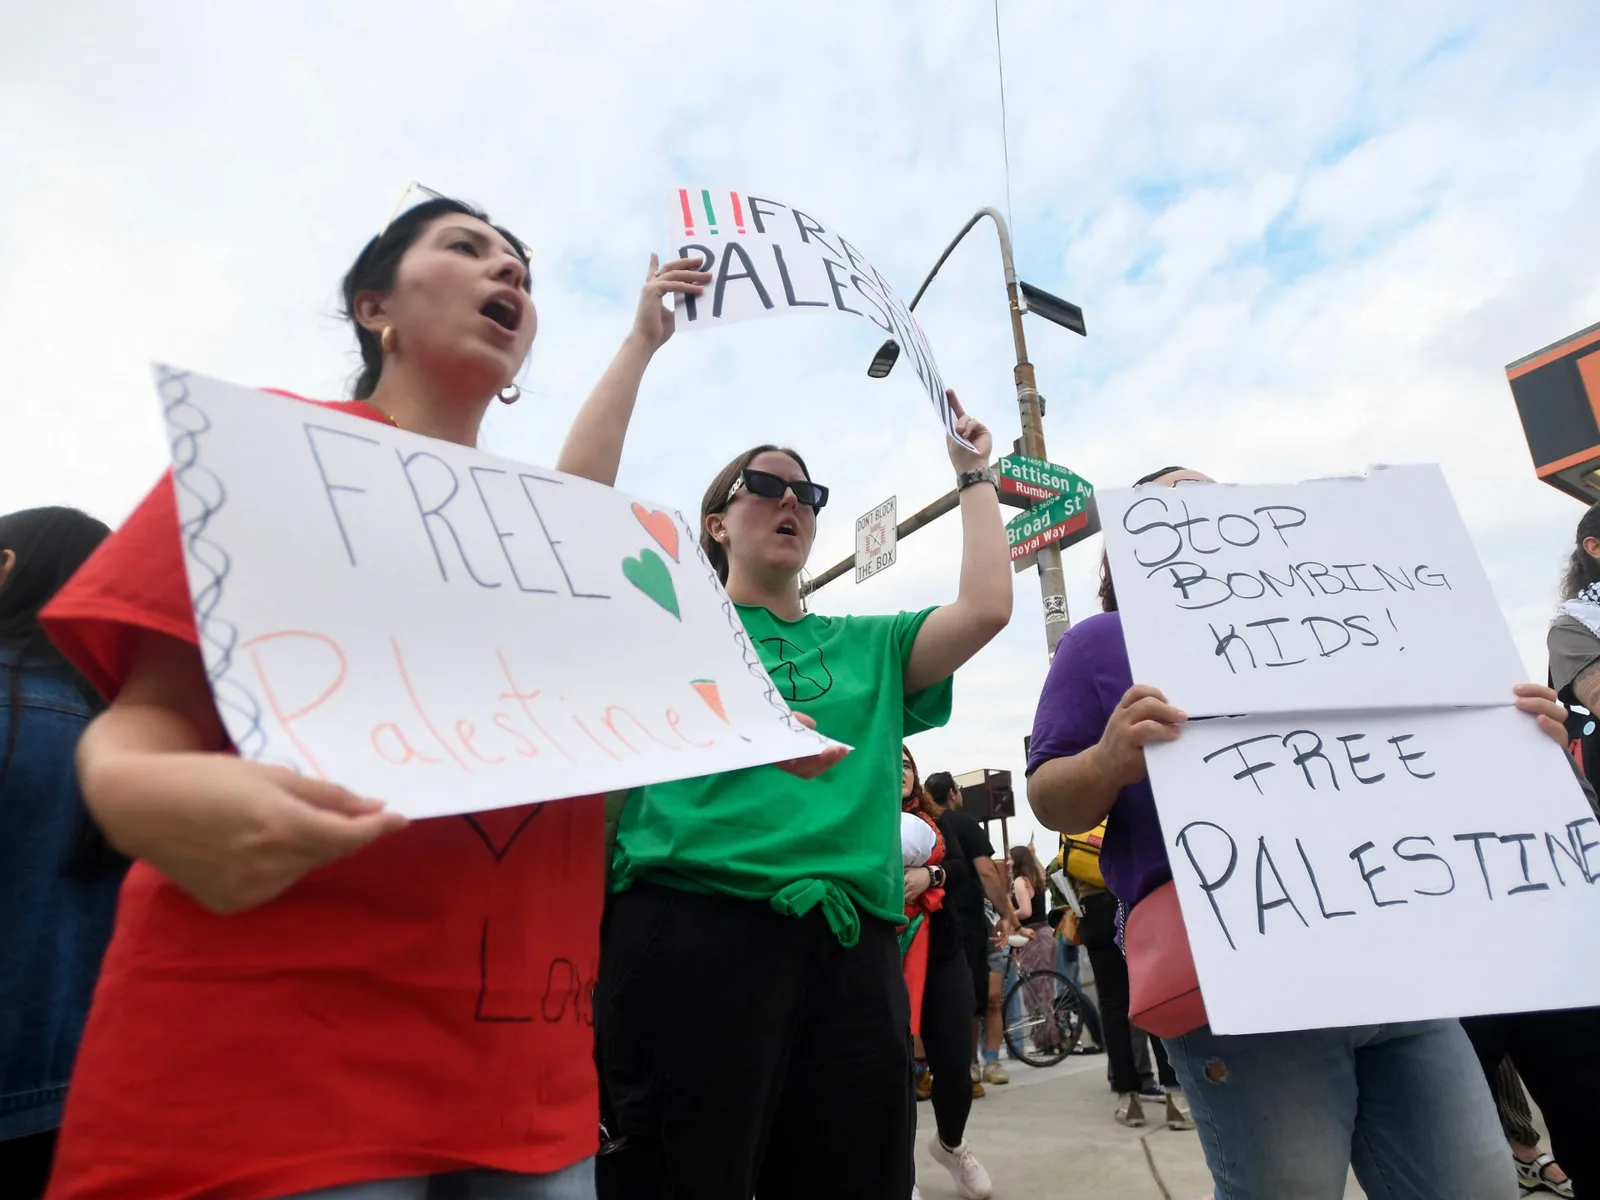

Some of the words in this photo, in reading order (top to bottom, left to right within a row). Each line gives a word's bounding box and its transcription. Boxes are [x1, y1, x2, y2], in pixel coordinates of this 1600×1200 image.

[1000, 458, 1070, 492] Pattison
[1077, 481, 1092, 498] Av
[1043, 461, 1051, 471] W
[303, 422, 611, 599] FREE
[875, 501, 895, 519] BLOCK
[1006, 509, 1051, 545] Broad
[1064, 495, 1082, 516] St
[1031, 505, 1038, 515] S
[1011, 535, 1040, 558] Royal
[1043, 524, 1066, 542] Way
[858, 561, 873, 580] THE
[876, 549, 894, 570] BOX
[1146, 560, 1453, 610] BOMBING
[1208, 607, 1406, 675] KIDS!
[1202, 729, 1437, 796] FREE
[1175, 816, 1600, 951] PALESTINE
